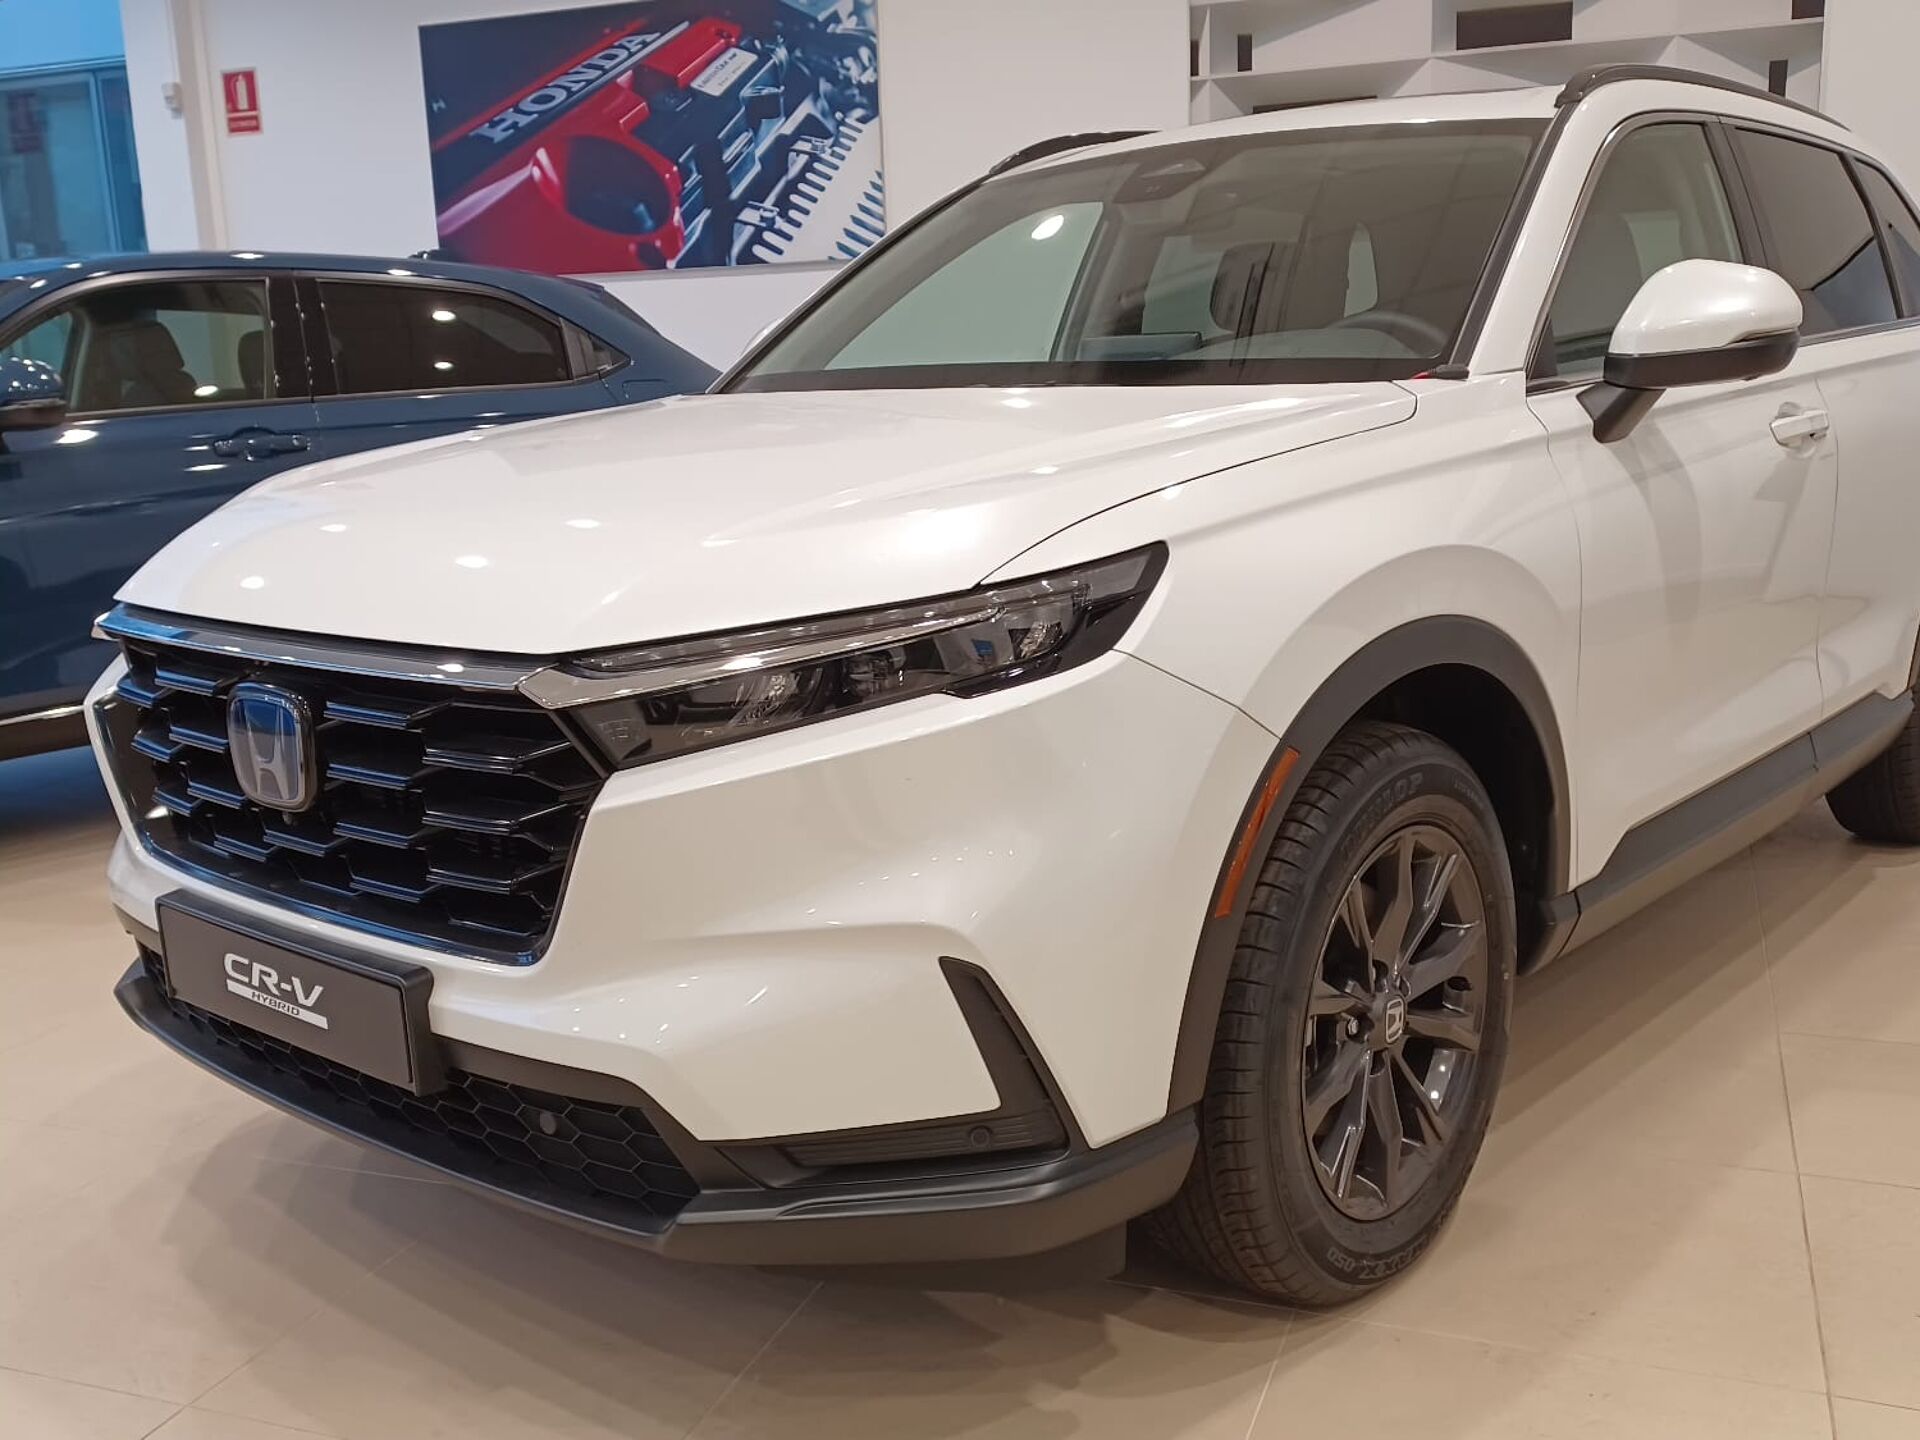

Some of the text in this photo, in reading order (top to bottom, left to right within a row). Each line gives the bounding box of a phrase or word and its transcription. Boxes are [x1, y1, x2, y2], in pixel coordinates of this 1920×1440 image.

[468, 32, 662, 144] HONDA
[223, 953, 325, 1008] CR-V
[251, 990, 301, 1017] HYBRID
